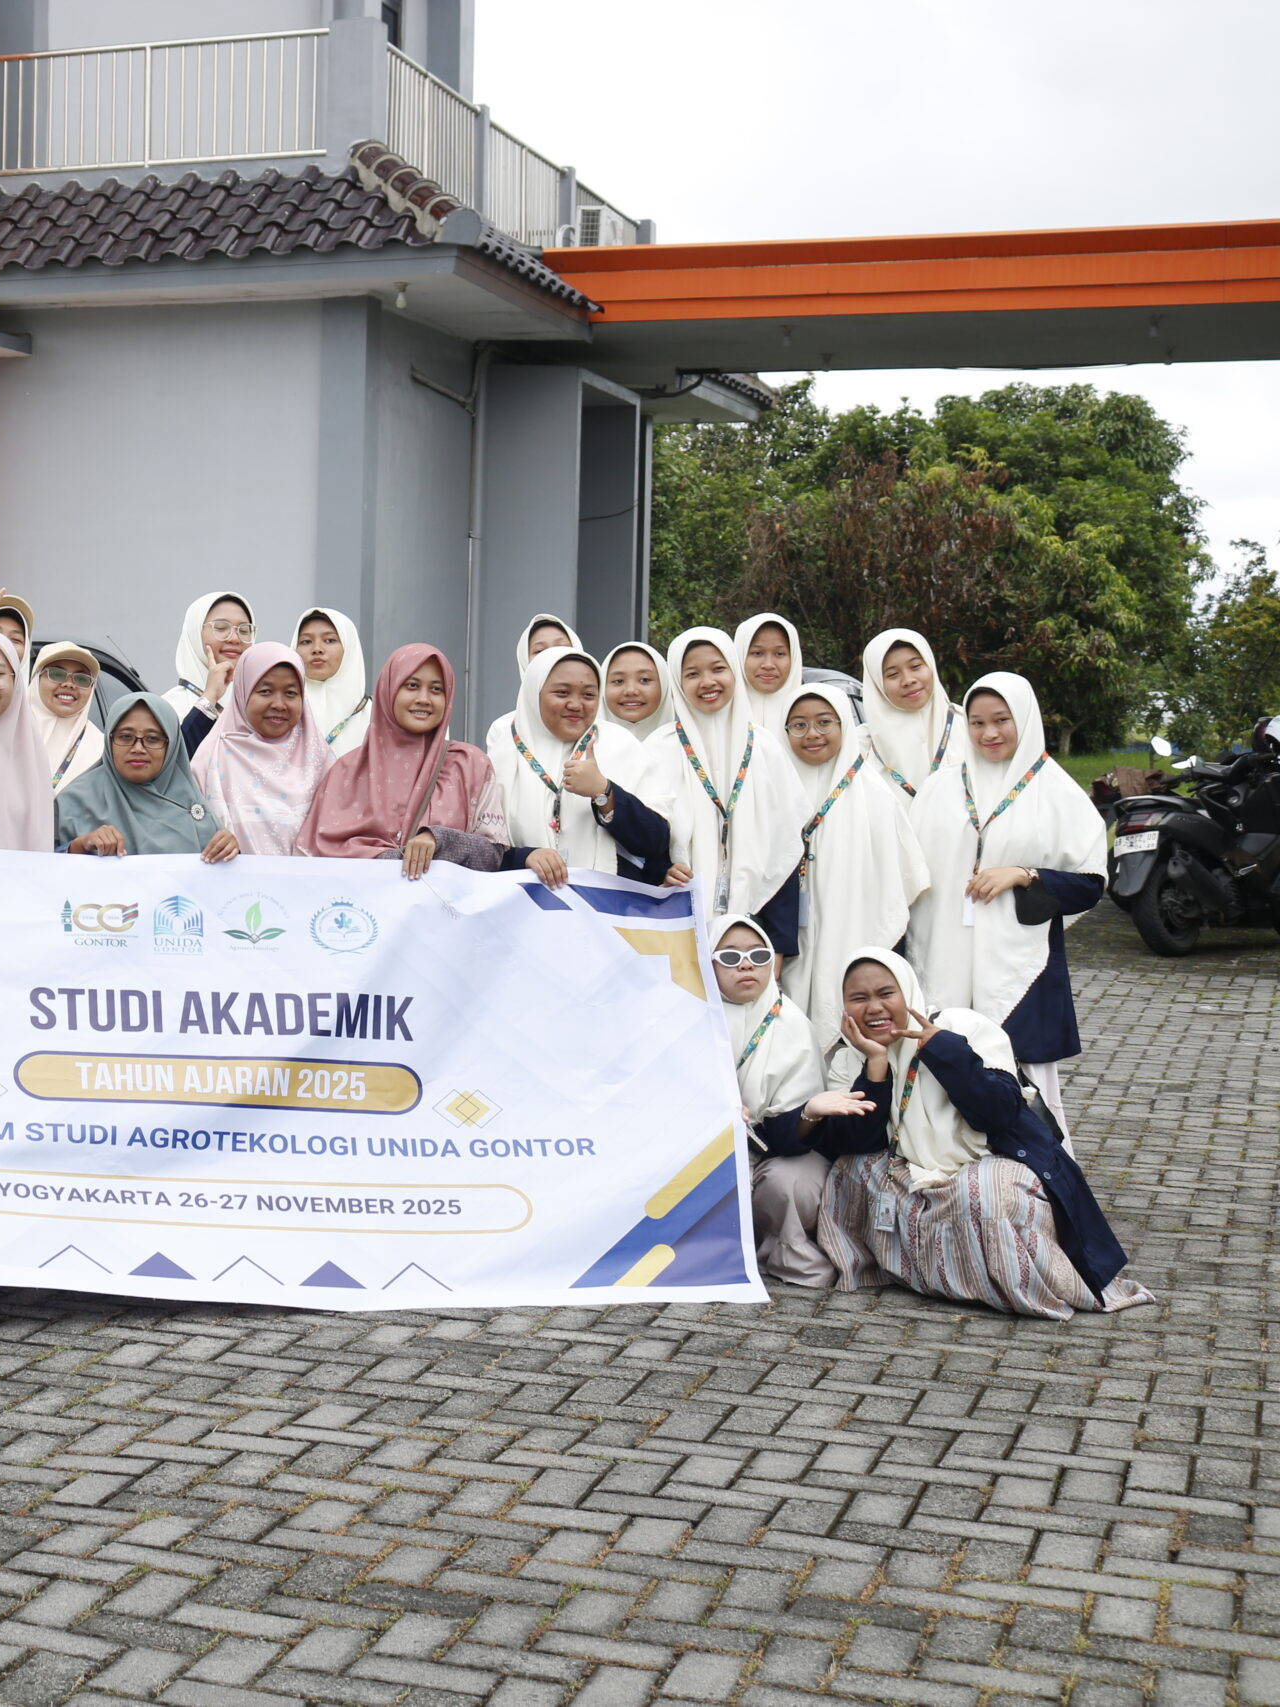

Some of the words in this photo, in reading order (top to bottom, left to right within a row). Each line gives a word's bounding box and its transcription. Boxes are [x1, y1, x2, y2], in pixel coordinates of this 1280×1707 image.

[74, 938, 128, 948] GONTOR
[154, 937, 202, 947] UNIDA
[29, 987, 163, 1033] STUDI
[179, 991, 414, 1041] AKADEMIK
[75, 1062, 174, 1092] TAHUN
[183, 1065, 290, 1097] AJARAN
[296, 1069, 367, 1101] 2025
[25, 1122, 118, 1146] STUDI
[127, 1126, 358, 1156] AGROTEKOLOGI
[367, 1137, 461, 1158] UNIDA
[469, 1138, 596, 1158] GONTOR
[178, 1192, 248, 1210] 26-27
[256, 1195, 395, 1215] NOVEMBER
[402, 1198, 462, 1215] 2025
